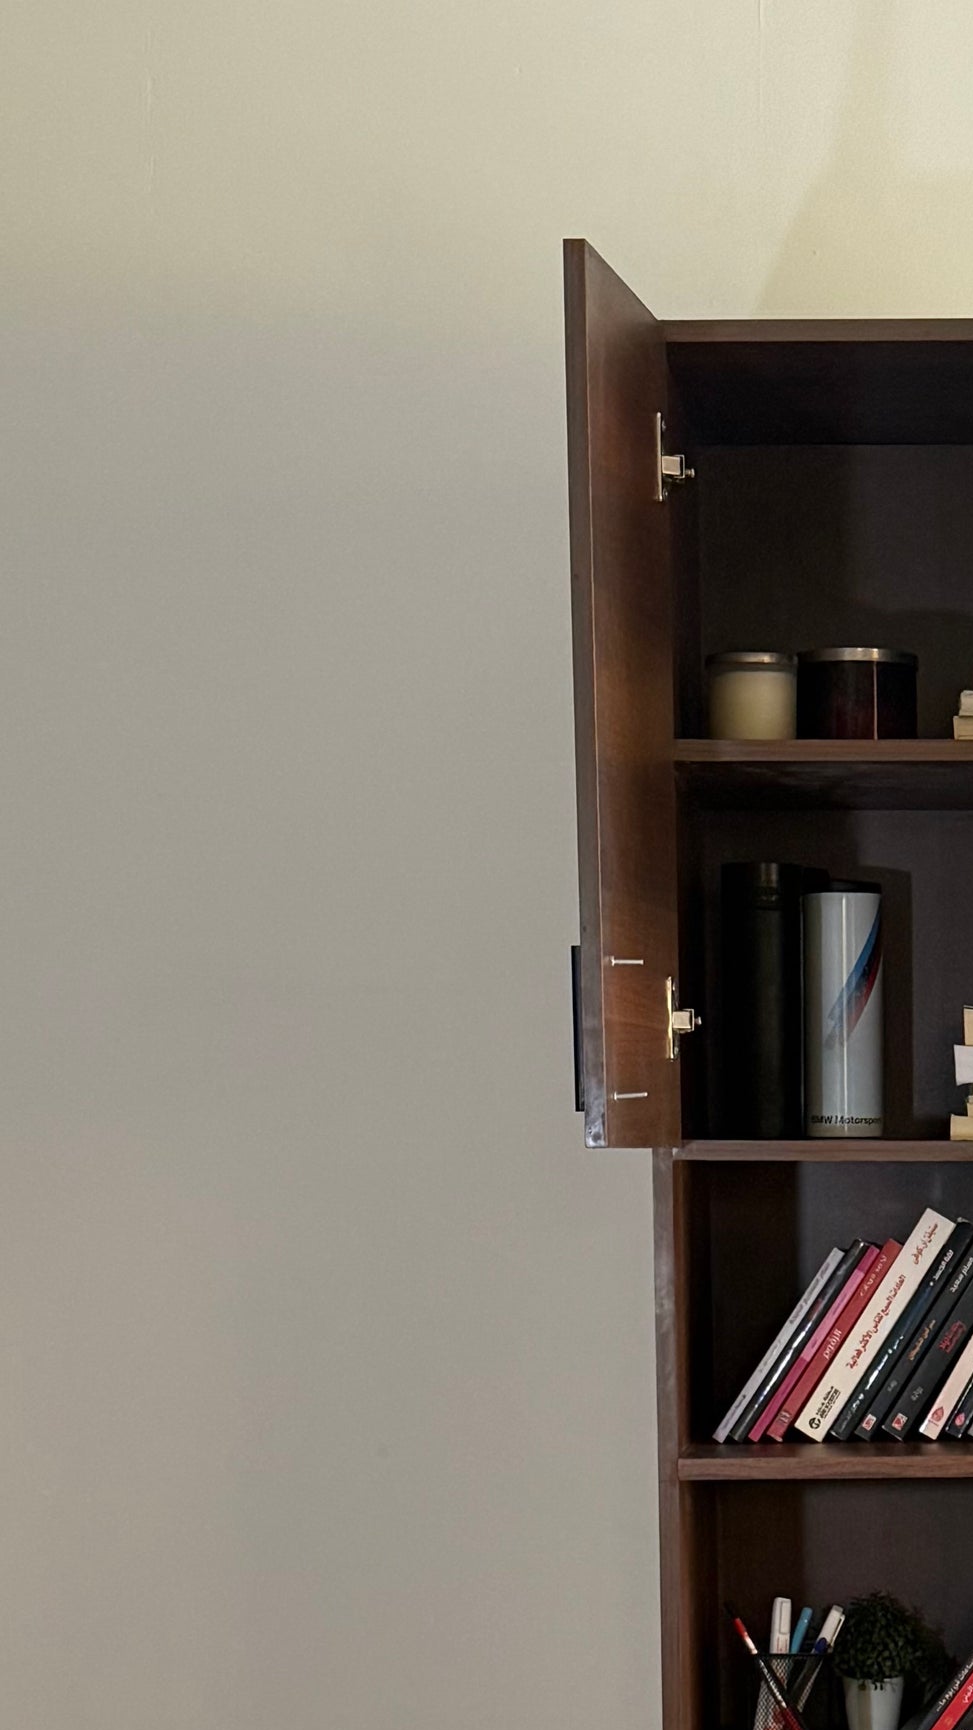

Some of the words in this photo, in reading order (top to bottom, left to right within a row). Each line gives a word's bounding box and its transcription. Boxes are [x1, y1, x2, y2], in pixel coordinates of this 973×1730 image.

[889, 1273, 907, 1297] العادات
[948, 1272, 965, 1293] سعيد
[878, 1294, 896, 1316] السبع
[867, 1311, 886, 1333] للناس
[856, 1328, 875, 1350] الأكثر
